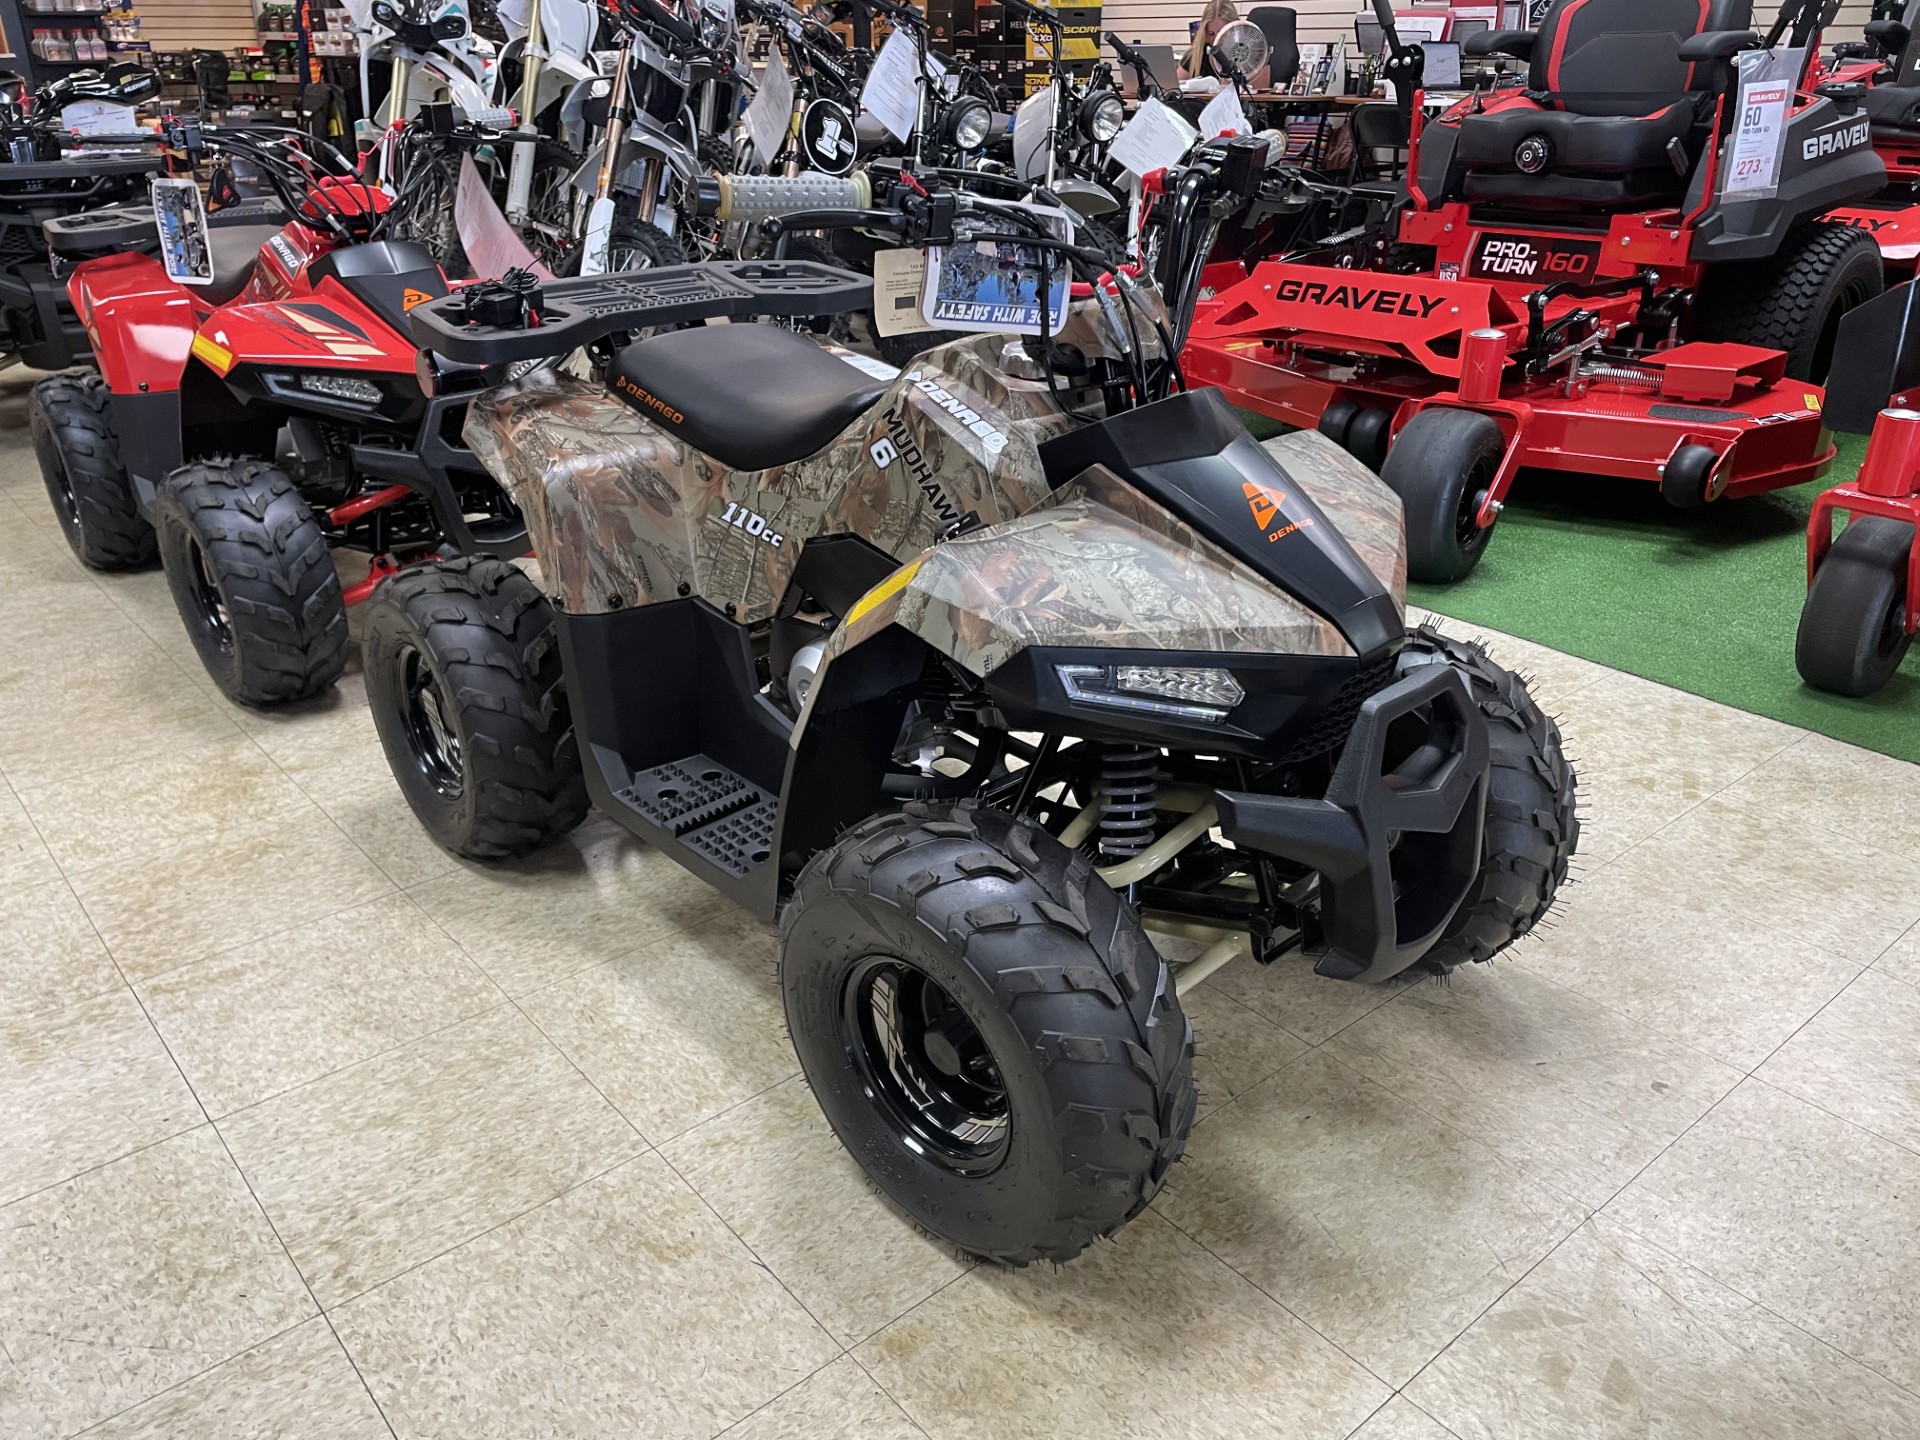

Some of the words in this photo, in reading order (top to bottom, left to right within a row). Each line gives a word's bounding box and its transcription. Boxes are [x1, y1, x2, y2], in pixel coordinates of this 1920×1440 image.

[1750, 92, 1781, 102] GRAVELY
[1744, 106, 1762, 127] 60
[1803, 121, 1870, 161] GRAVELY
[270, 236, 299, 268] DENAGO
[1483, 241, 1538, 258] PRO-
[1481, 256, 1538, 275] TURN
[1542, 251, 1589, 274] 160
[1439, 271, 1457, 281] USA
[1276, 279, 1447, 319] GRAVELY
[936, 303, 991, 321] SAFETY
[992, 308, 1025, 323] WITH
[1028, 311, 1058, 326] RDE
[626, 383, 685, 425] DENAGO
[914, 380, 1009, 454] DENAGO
[870, 436, 900, 470] 6
[882, 407, 959, 521] MUDHAW
[719, 501, 784, 548] 110cc
[1268, 518, 1314, 543] DENAGO
